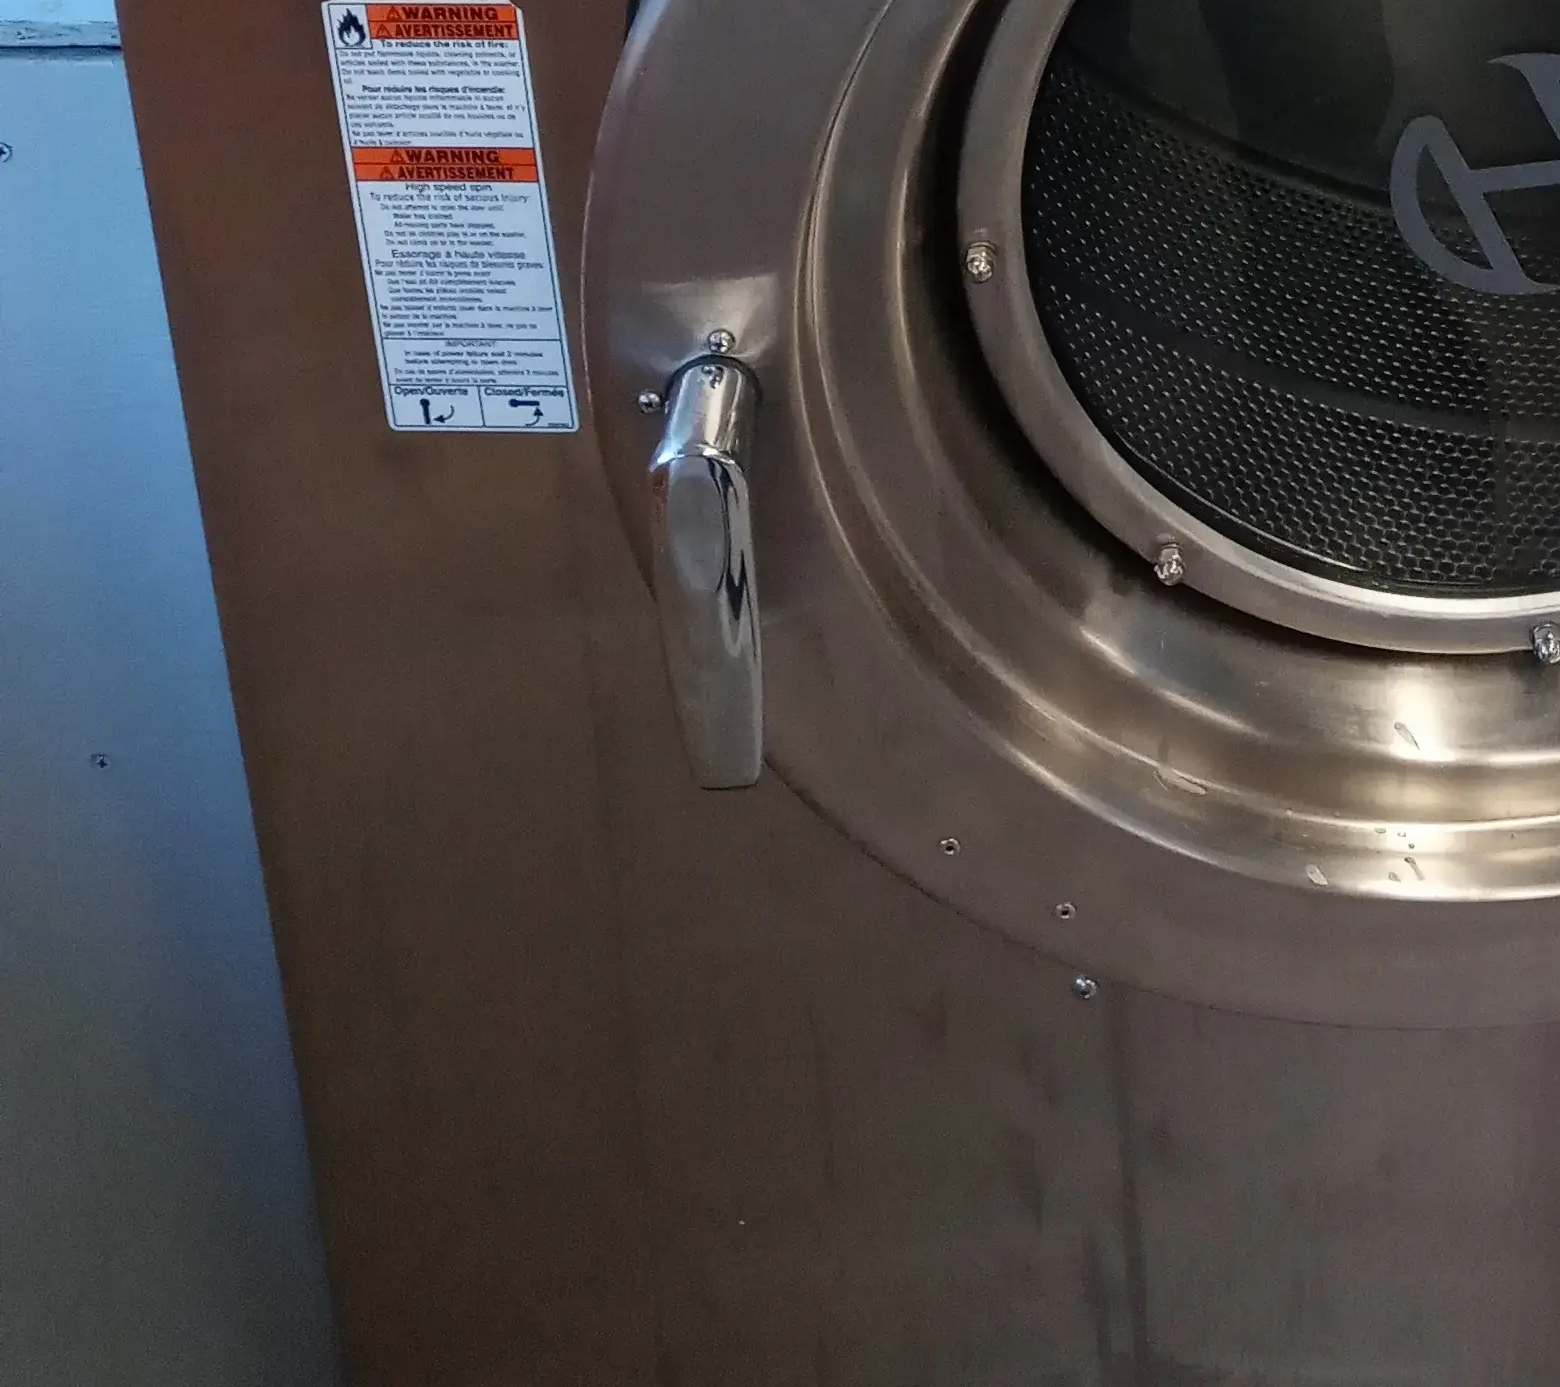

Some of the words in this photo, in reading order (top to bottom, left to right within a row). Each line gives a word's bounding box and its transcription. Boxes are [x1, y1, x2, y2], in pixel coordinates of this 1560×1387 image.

[402, 6, 498, 21] WARNING
[395, 24, 513, 38] AVERTISSEMENT
[381, 40, 392, 49] To
[395, 40, 430, 49] reduce
[433, 40, 450, 48] the
[452, 40, 472, 48] risk
[405, 150, 500, 164] WARNING
[397, 166, 515, 180] AVERTISSEMENT
[405, 183, 430, 193] High
[433, 184, 467, 193] speed
[394, 387, 468, 397] Open/Ouverte
